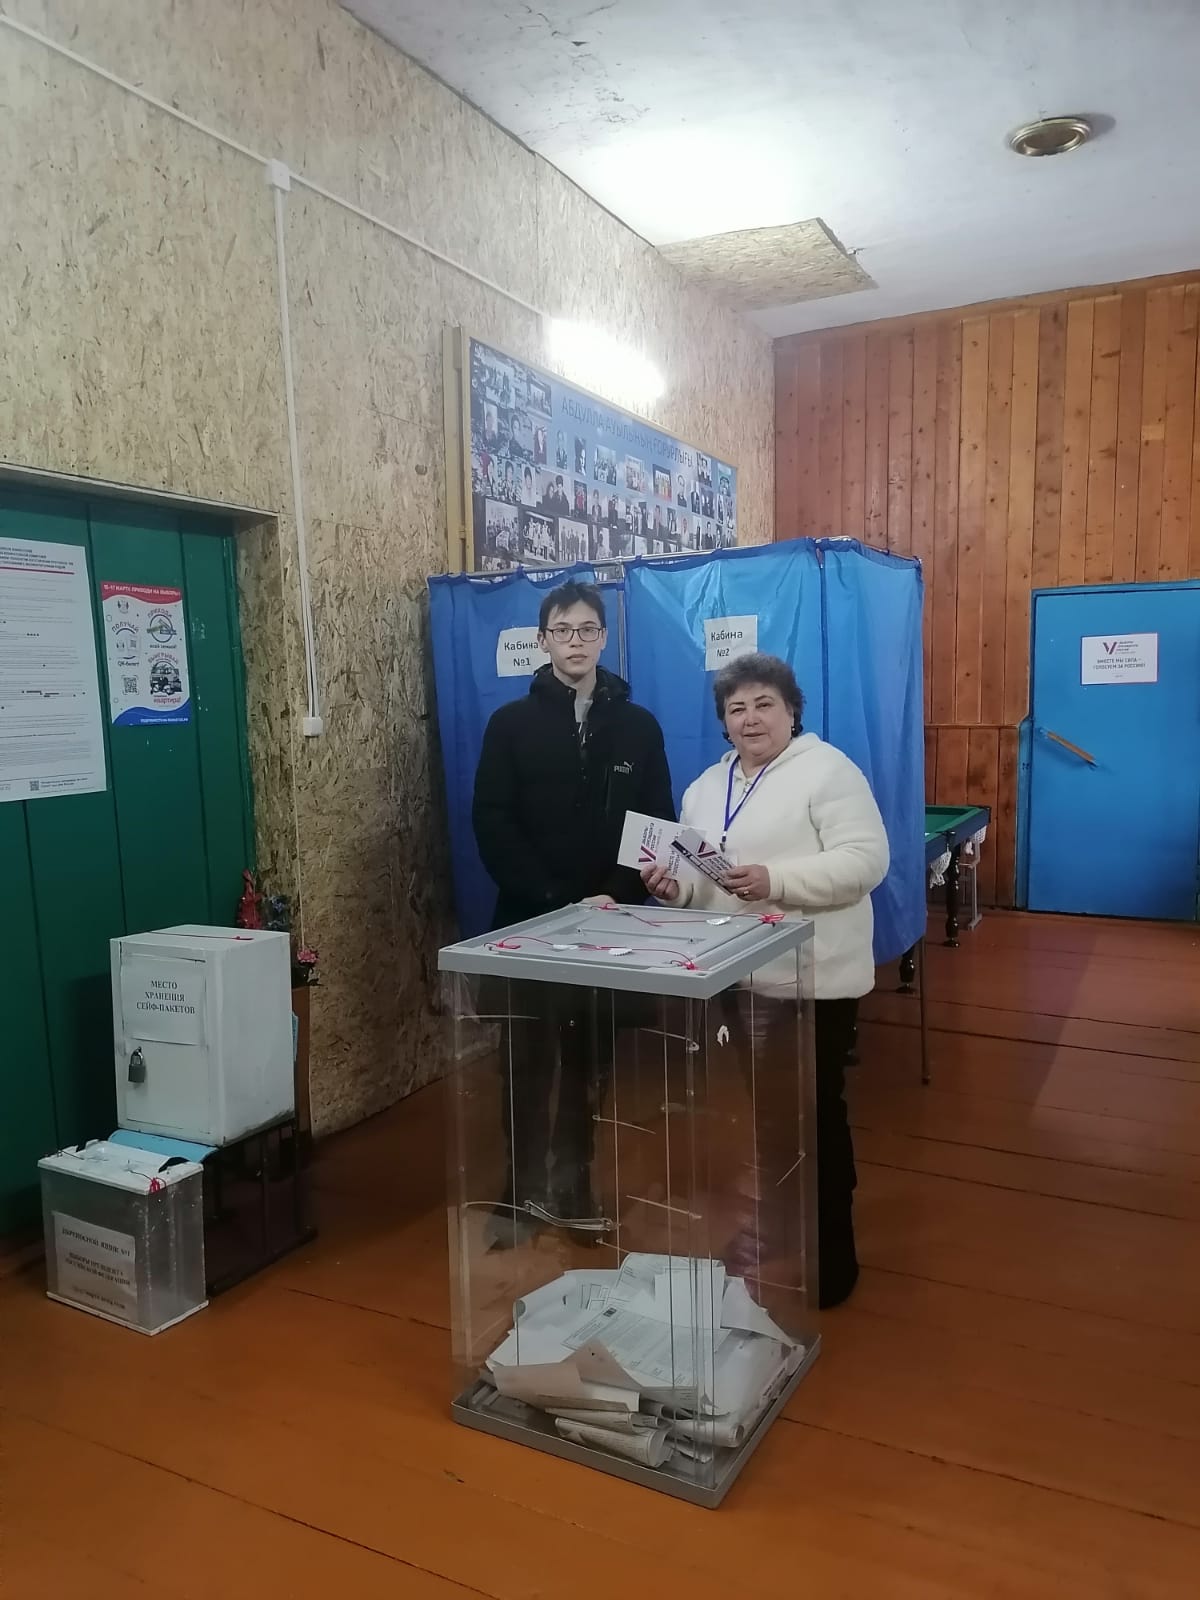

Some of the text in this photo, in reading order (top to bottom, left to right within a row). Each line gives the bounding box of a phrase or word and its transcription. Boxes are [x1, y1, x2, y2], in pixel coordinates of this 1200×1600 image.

[561, 396, 605, 430] АБДУЛЛА
[711, 629, 743, 642] Кабина
[504, 640, 539, 651] Кабина
[716, 648, 730, 657] №2
[513, 657, 531, 667] №1
[151, 980, 178, 990] МЕСТО
[144, 991, 185, 1002] ХРАНЕНИЯ
[136, 1001, 196, 1015] СЕЙФ-ПАКЕТОВ
